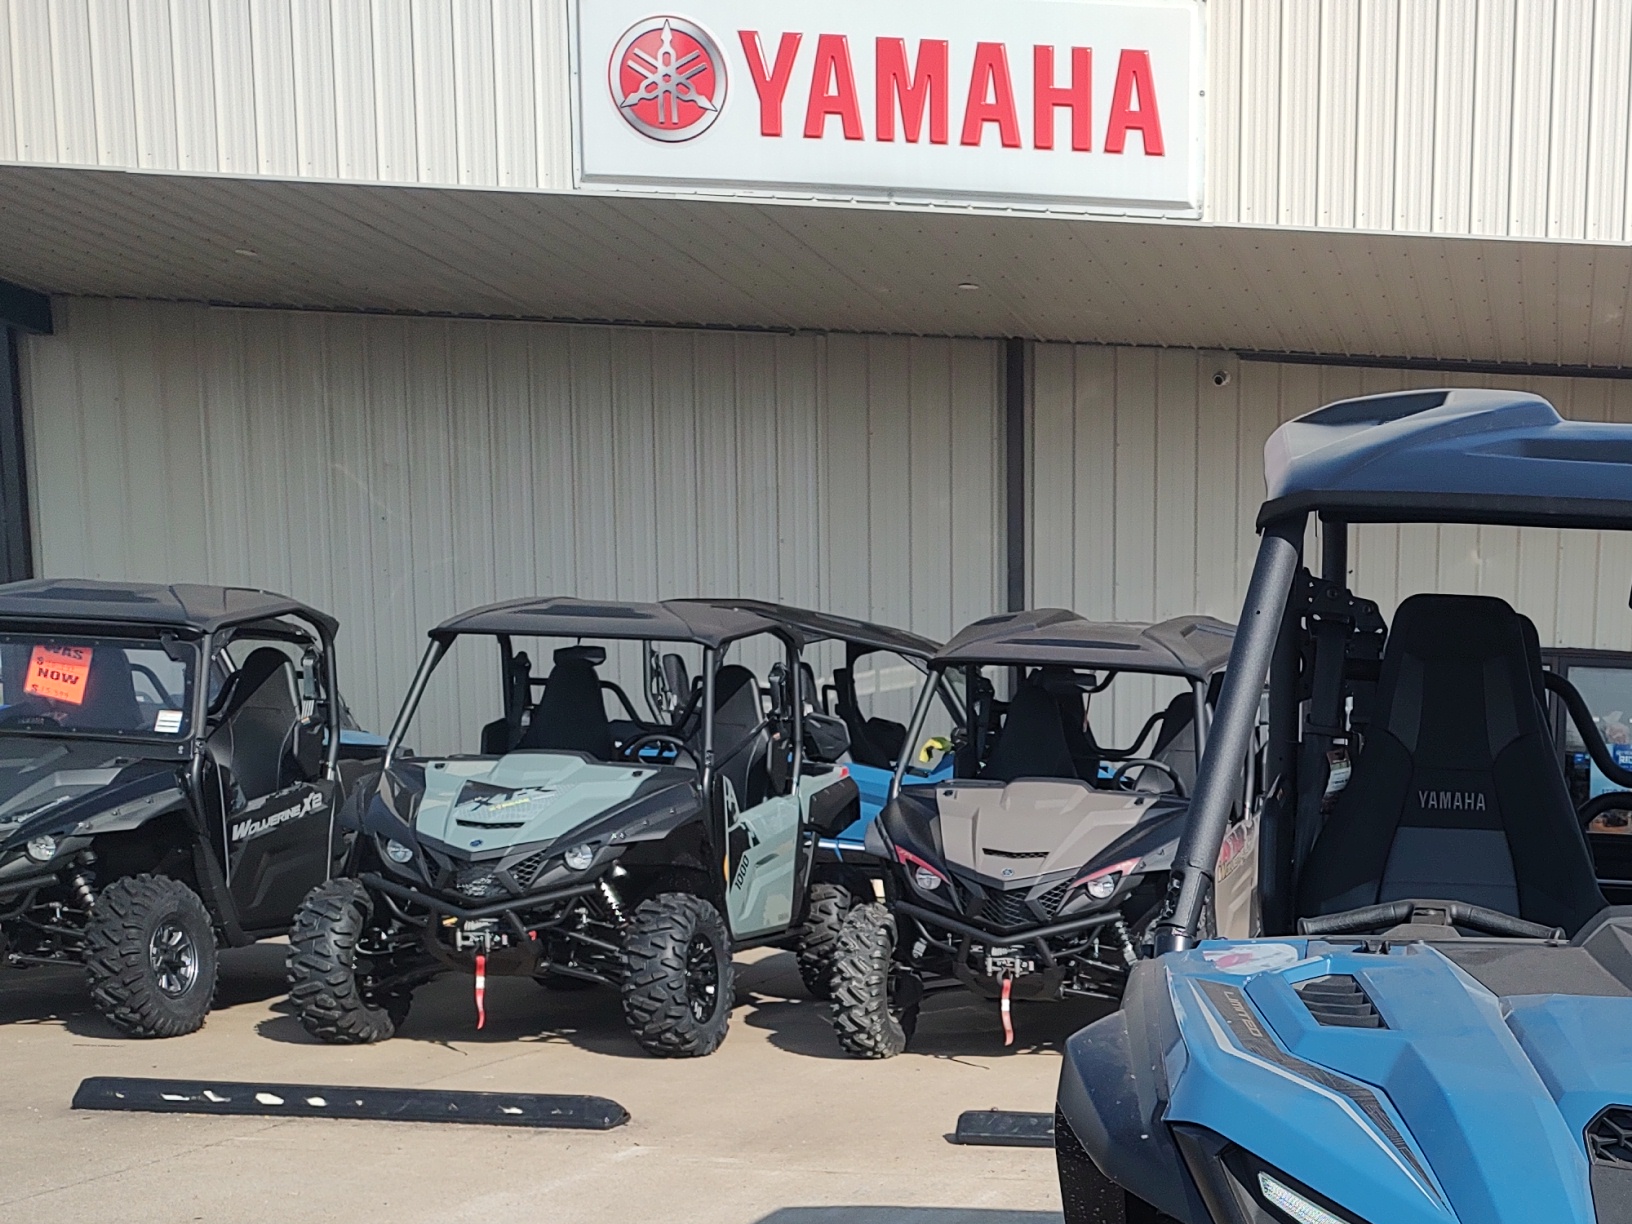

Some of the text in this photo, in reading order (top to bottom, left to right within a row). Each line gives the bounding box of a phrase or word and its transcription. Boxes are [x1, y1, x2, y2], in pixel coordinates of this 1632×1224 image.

[737, 30, 1165, 156] YAMAHA
[38, 667, 80, 685] NOW
[232, 792, 323, 841] WOLVERINE X2
[1418, 790, 1486, 811] YAMAHA
[735, 854, 750, 890] 1000
[1223, 990, 1264, 1038] LIMITED
